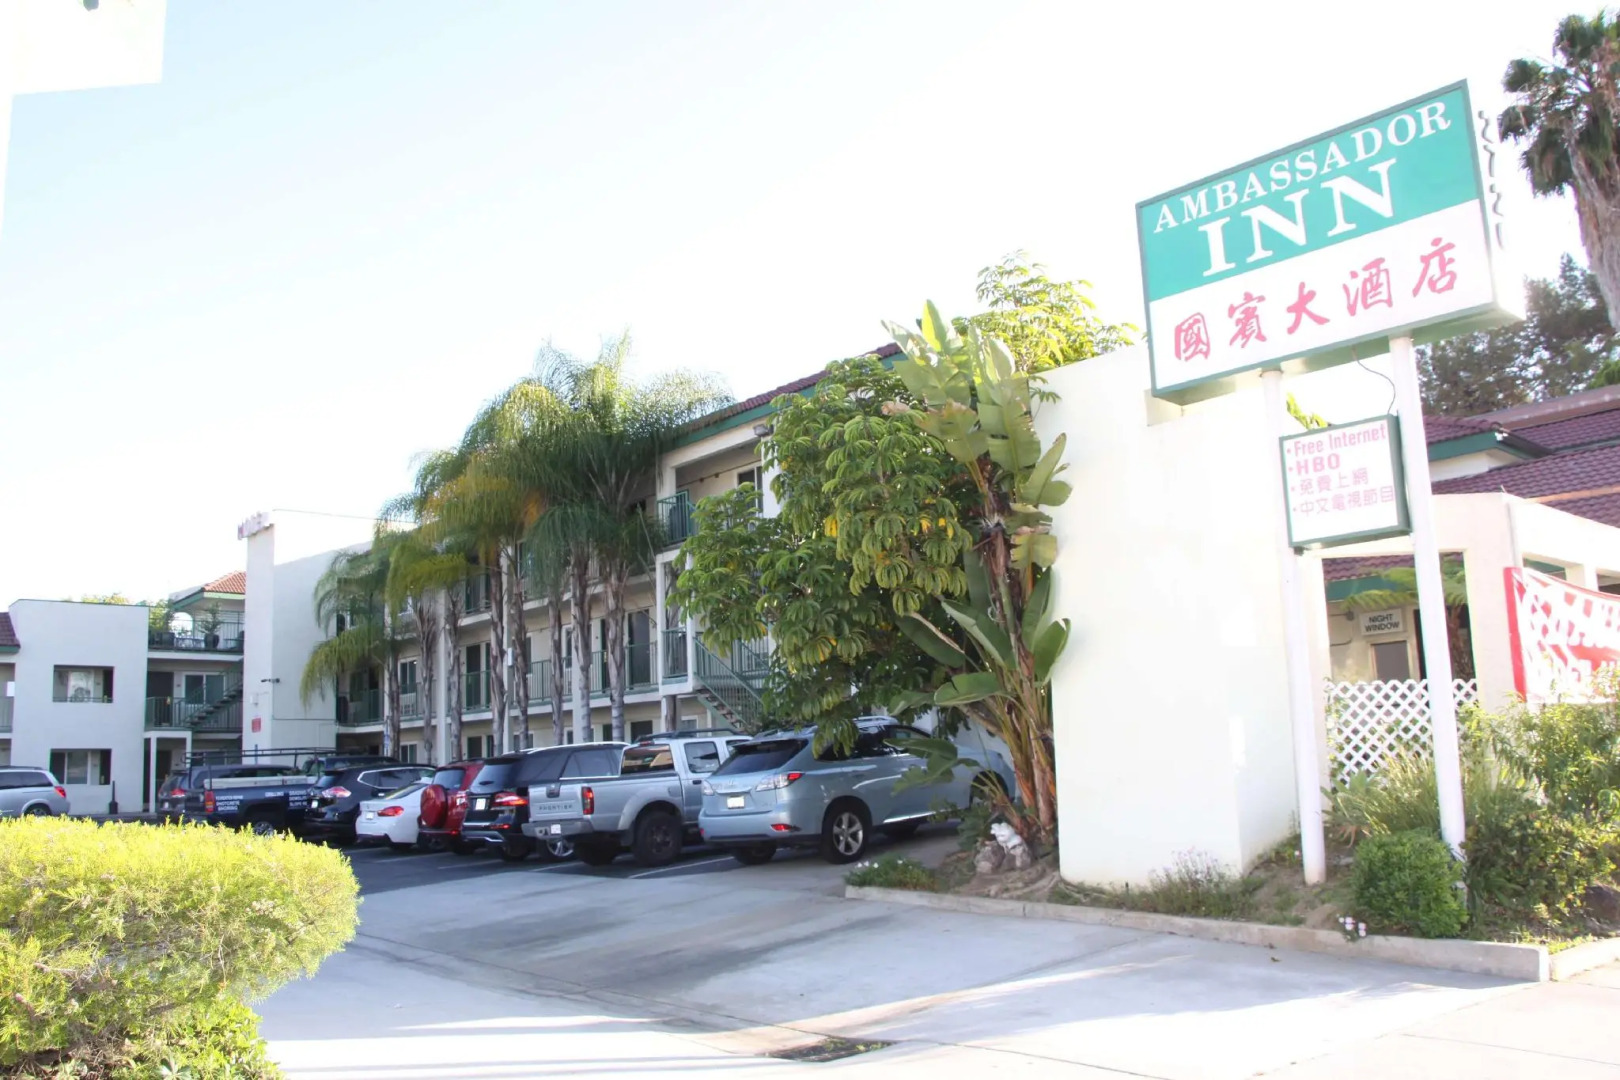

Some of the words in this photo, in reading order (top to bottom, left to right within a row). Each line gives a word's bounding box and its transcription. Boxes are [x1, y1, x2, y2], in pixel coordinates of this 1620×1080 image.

[1153, 101, 1452, 234] AMBASSADOR
[1198, 158, 1397, 277] INN
[1174, 237, 1457, 362] 國賓大酒店
[1294, 439, 1324, 457] Free
[1328, 423, 1387, 450] Internet
[1296, 453, 1341, 476] HBO
[1364, 621, 1400, 632] WINDOW
[1368, 613, 1394, 623] NIGHT
